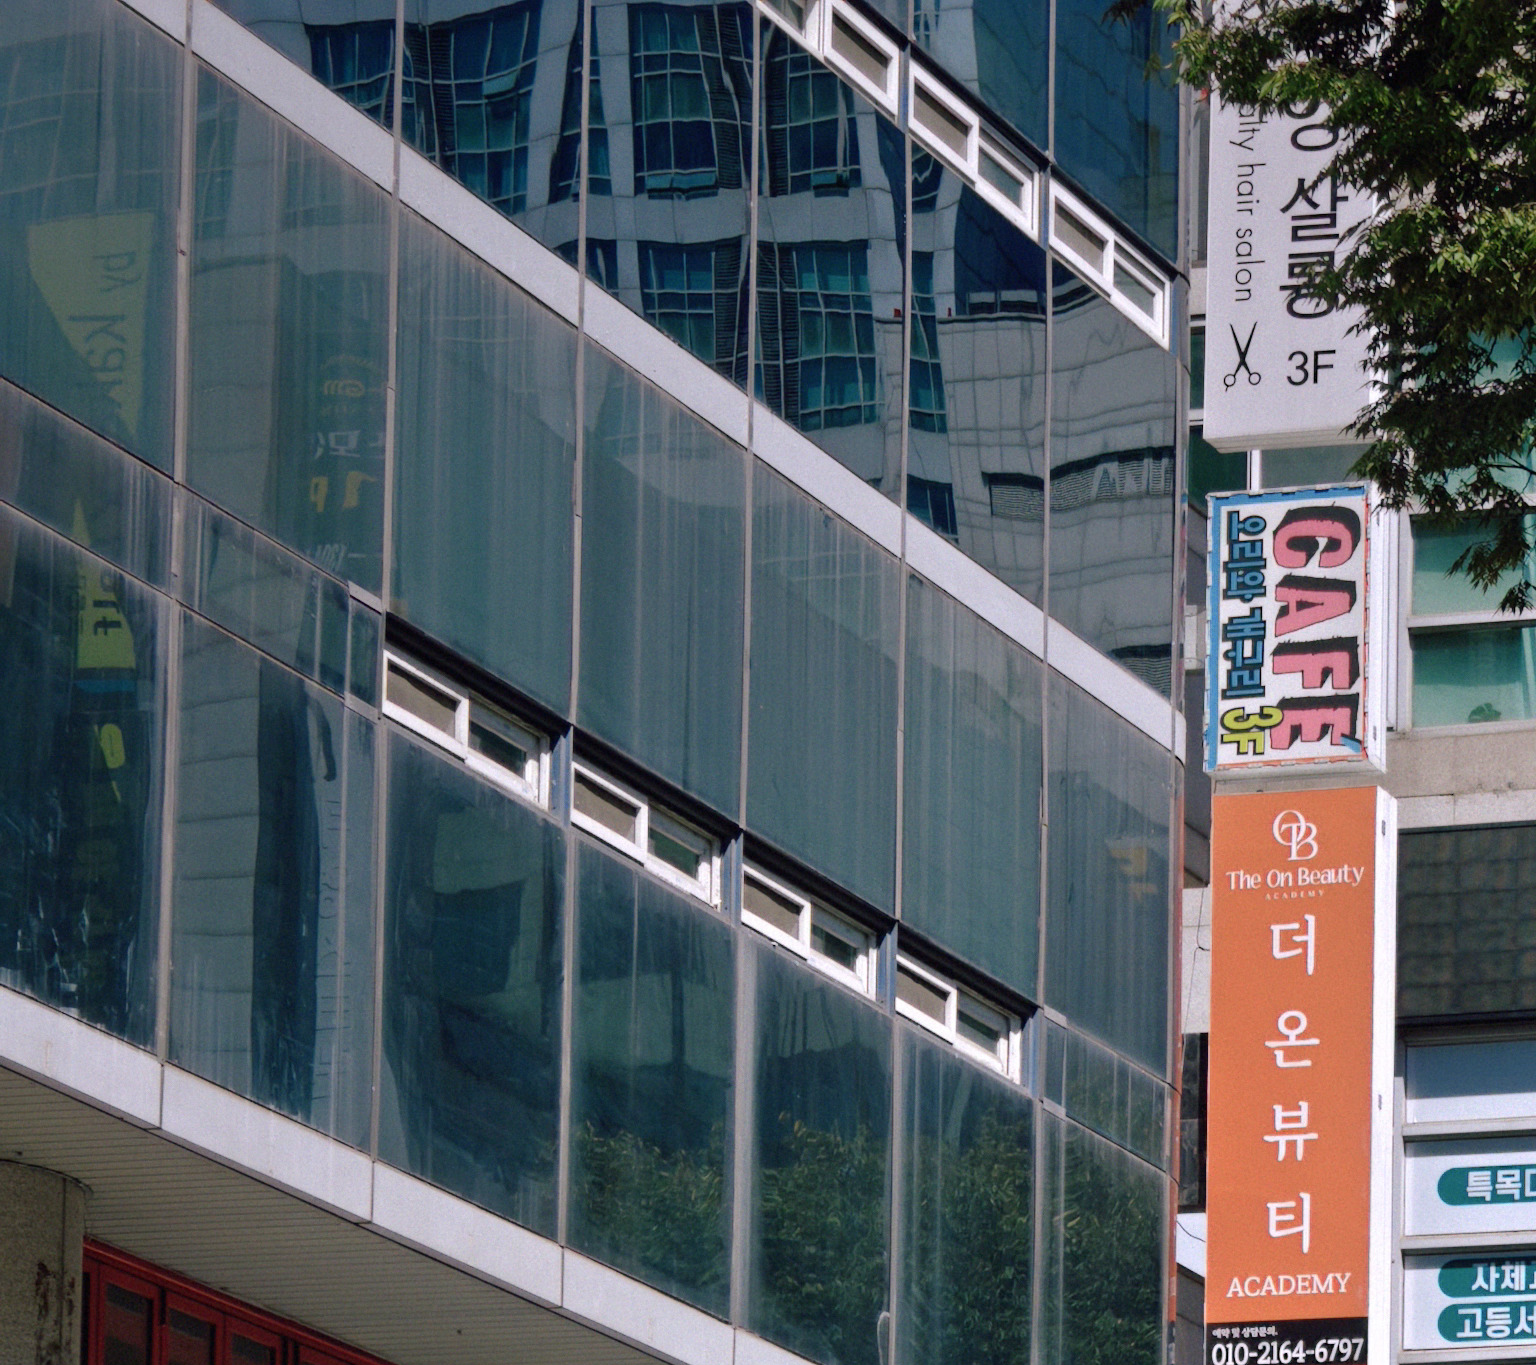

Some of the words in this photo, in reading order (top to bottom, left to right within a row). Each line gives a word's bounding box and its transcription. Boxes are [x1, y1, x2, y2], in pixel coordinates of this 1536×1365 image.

[1234, 163, 1267, 215] hair
[1233, 228, 1267, 303] salon
[1287, 350, 1336, 386] 3F
[1222, 510, 1267, 603] 오리와
[1221, 607, 1267, 700] 개구리
[1220, 705, 1285, 756] 3F
[1225, 869, 1262, 891] The
[1266, 868, 1293, 889] On
[1297, 864, 1365, 888] Beauty
[1265, 889, 1325, 901] ACADEMY
[1226, 1272, 1352, 1298] ACADEMY
